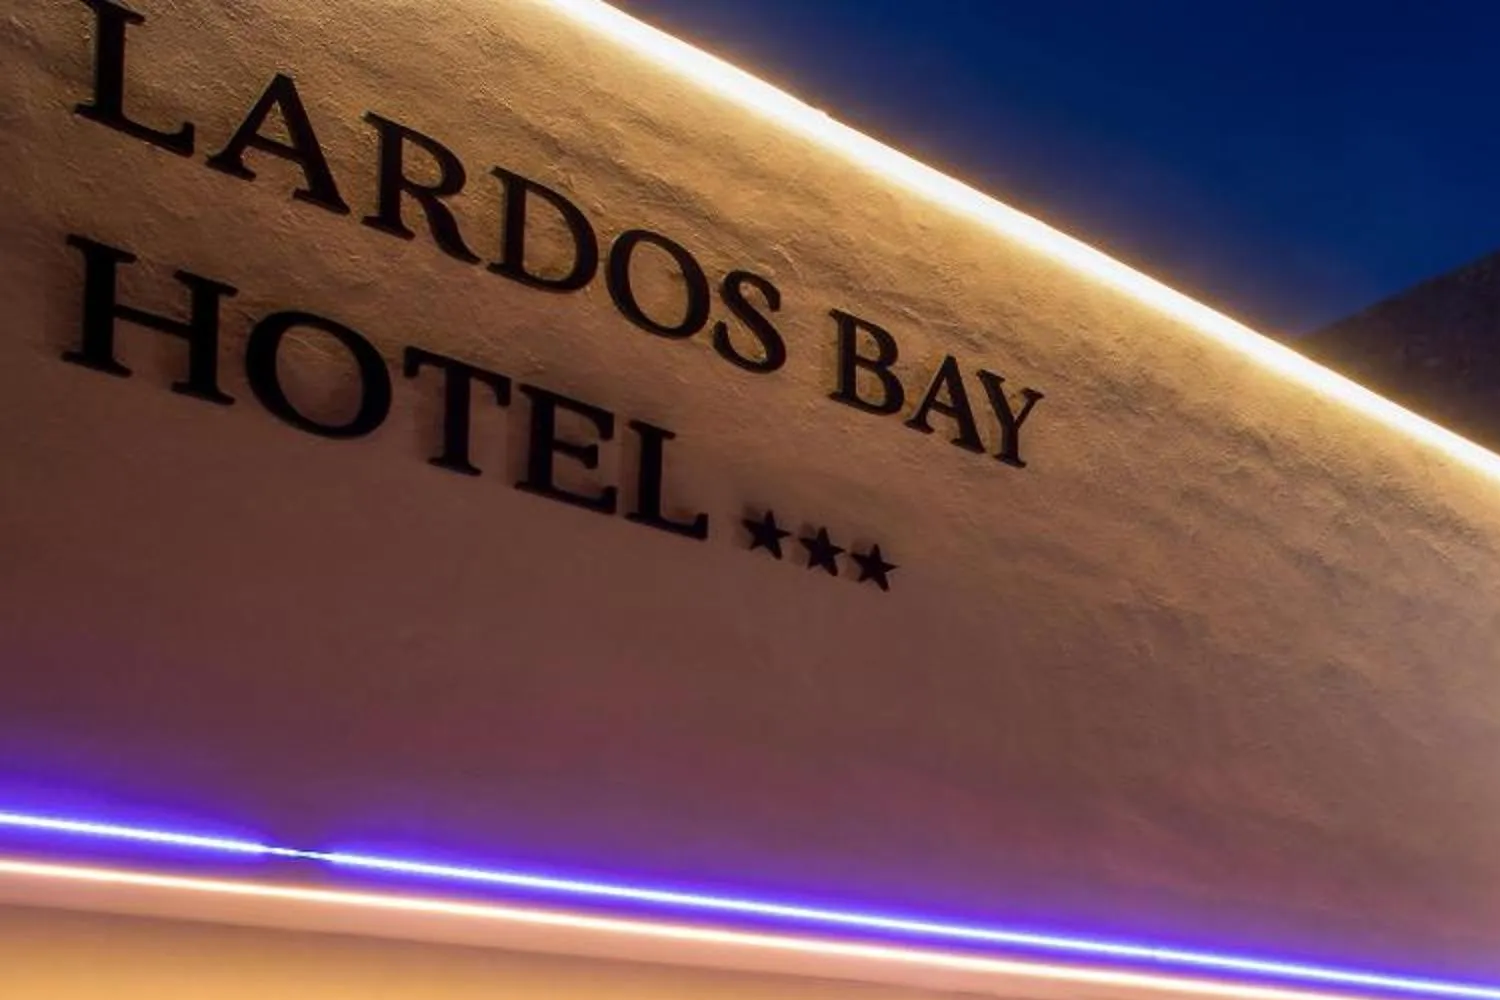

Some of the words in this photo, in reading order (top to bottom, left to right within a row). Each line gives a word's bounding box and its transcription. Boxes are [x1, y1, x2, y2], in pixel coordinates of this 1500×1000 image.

[60, 233, 709, 541] HOTEL
[74, 0, 787, 374] LARDOS
[826, 308, 1045, 467] BAY
